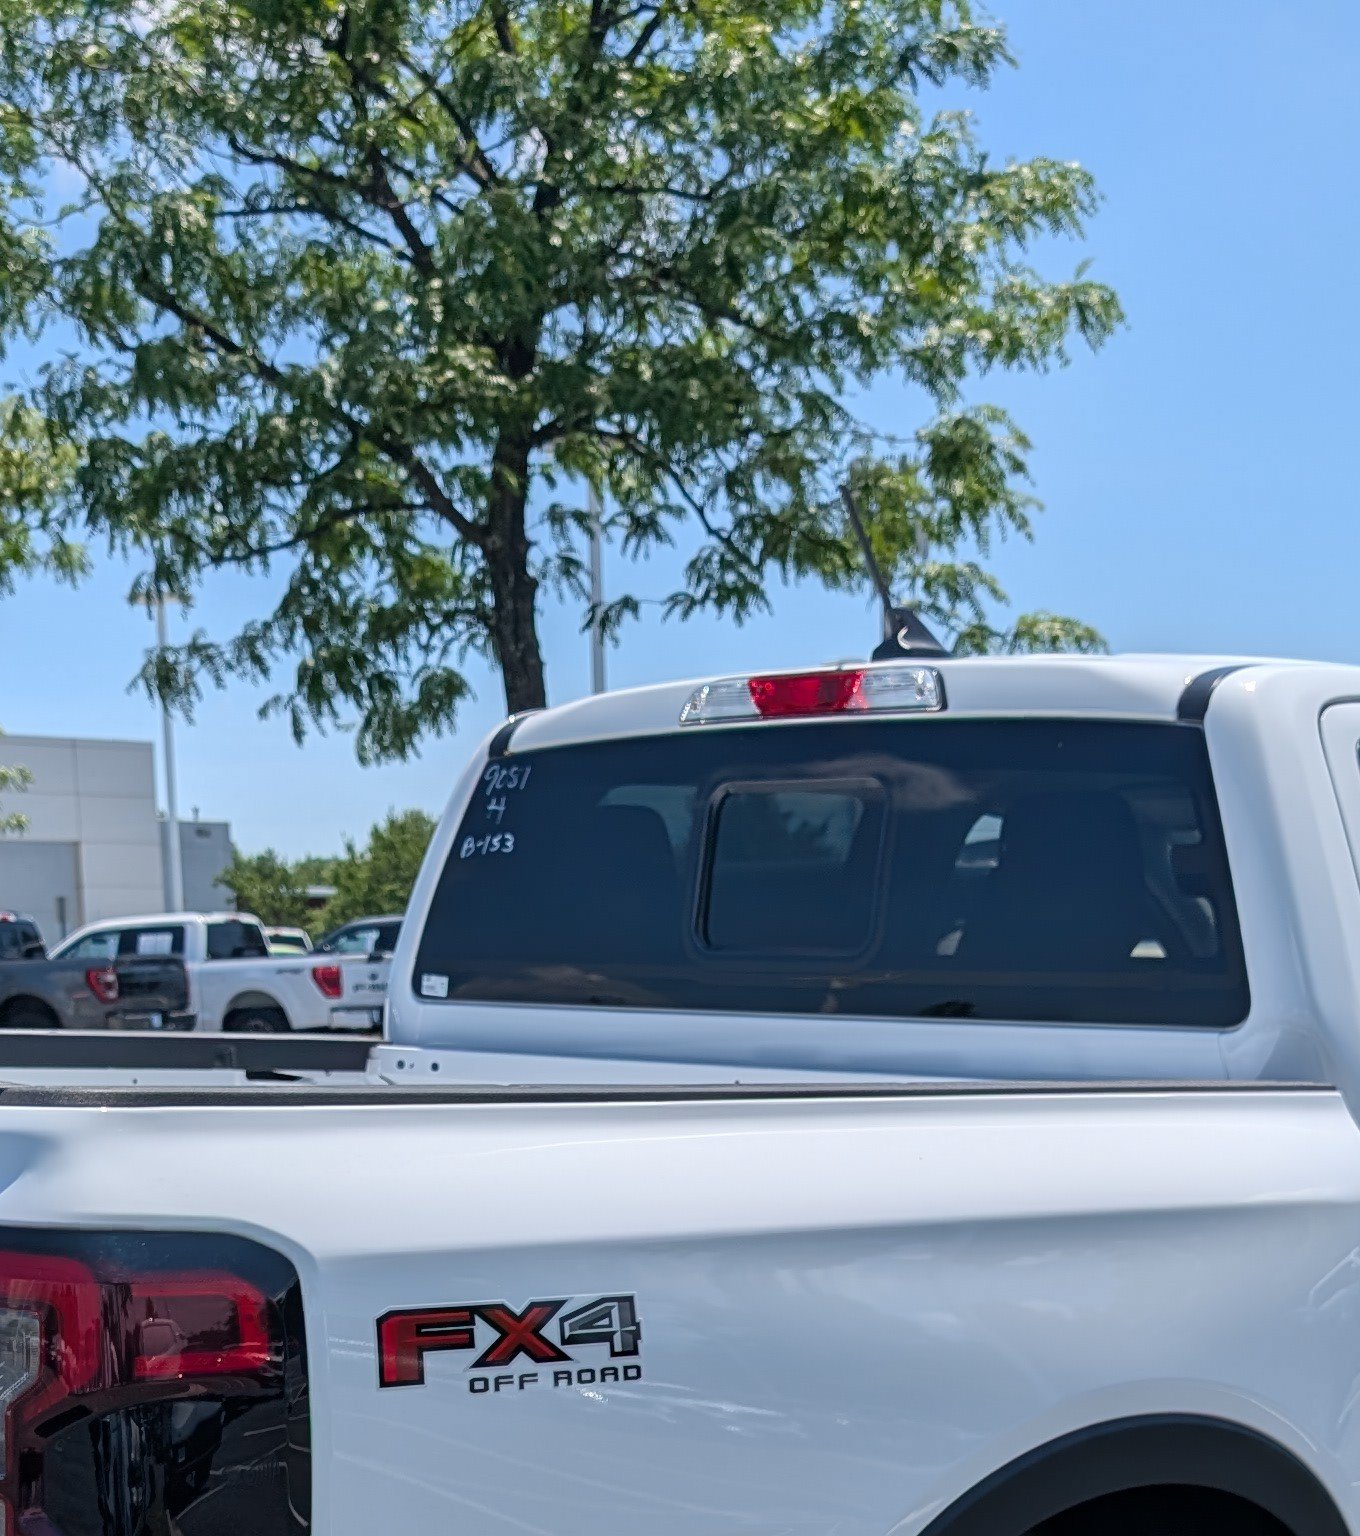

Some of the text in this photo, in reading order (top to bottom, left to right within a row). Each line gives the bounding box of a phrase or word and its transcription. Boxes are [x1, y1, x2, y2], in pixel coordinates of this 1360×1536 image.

[376, 1294, 642, 1389] FX4
[469, 1364, 642, 1394] OFF ROAD
